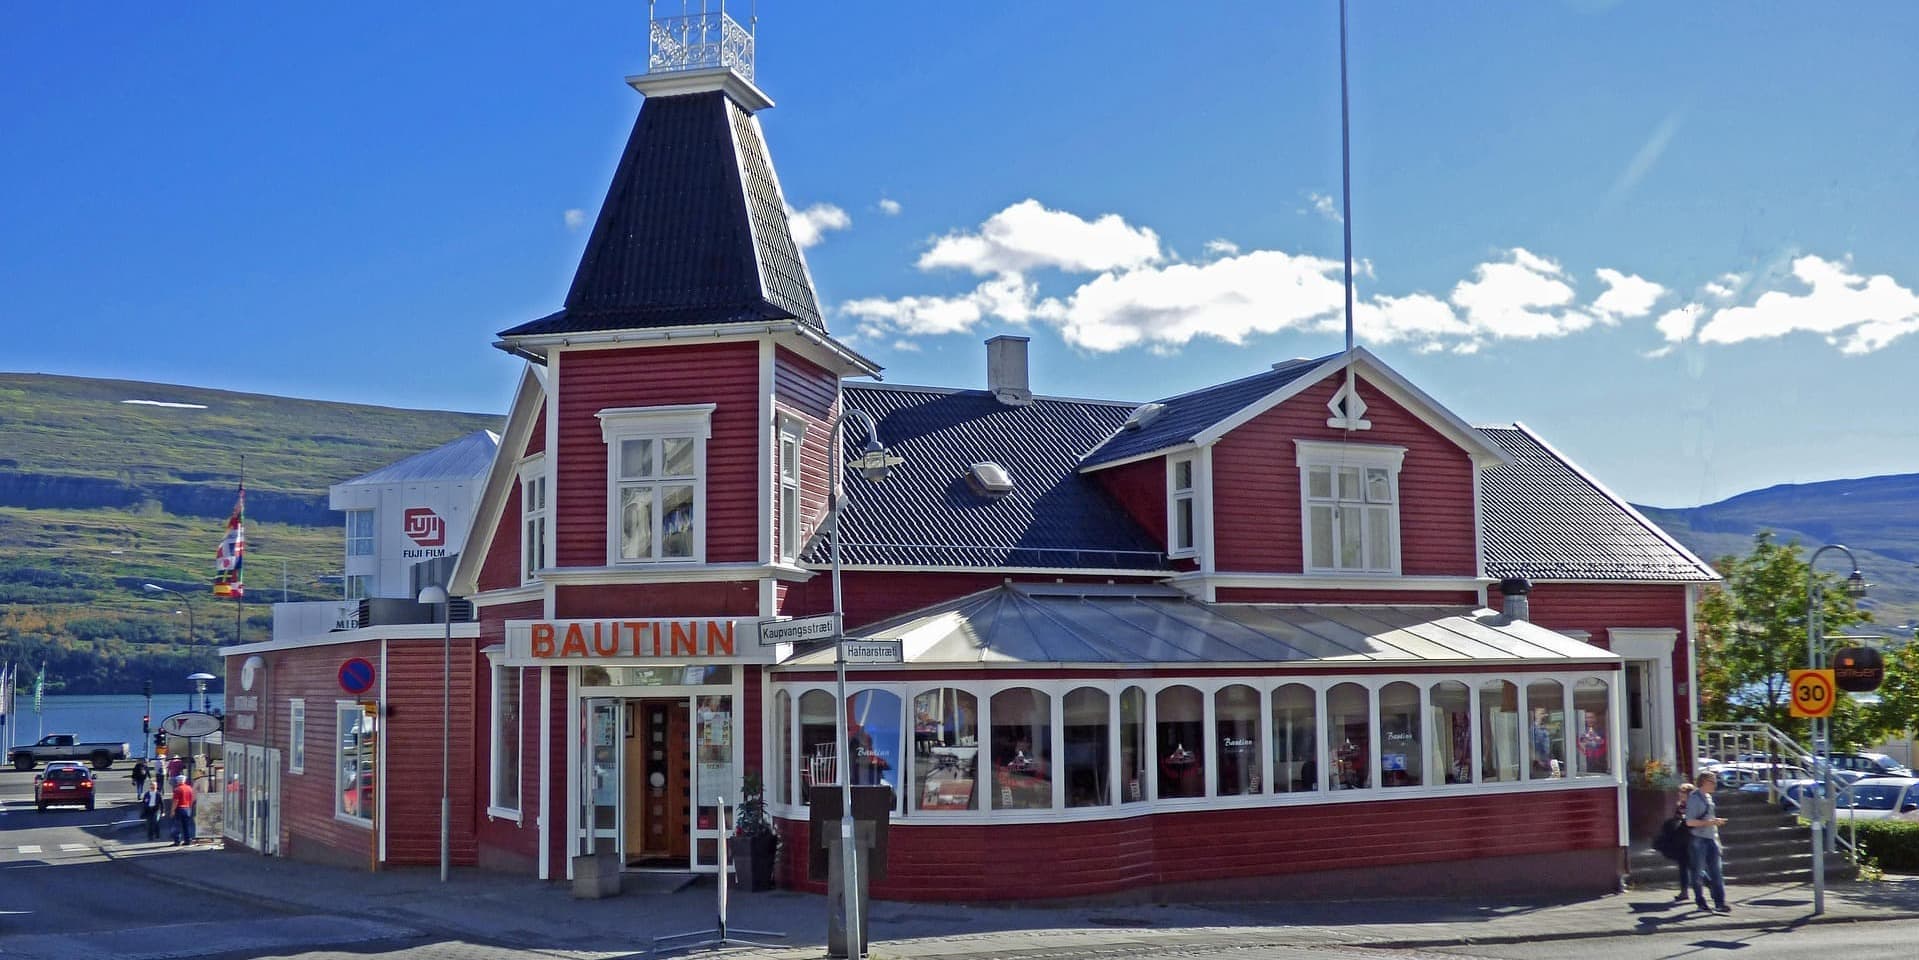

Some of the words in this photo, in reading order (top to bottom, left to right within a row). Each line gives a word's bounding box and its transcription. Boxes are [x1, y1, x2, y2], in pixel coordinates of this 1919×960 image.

[403, 549, 422, 558] FUJI
[426, 549, 445, 557] FILM
[531, 620, 735, 658] BAUTINN
[763, 622, 833, 640] Kaupvangsstræti
[847, 645, 898, 656] Hafnarstræti
[1799, 685, 1825, 701] 30
